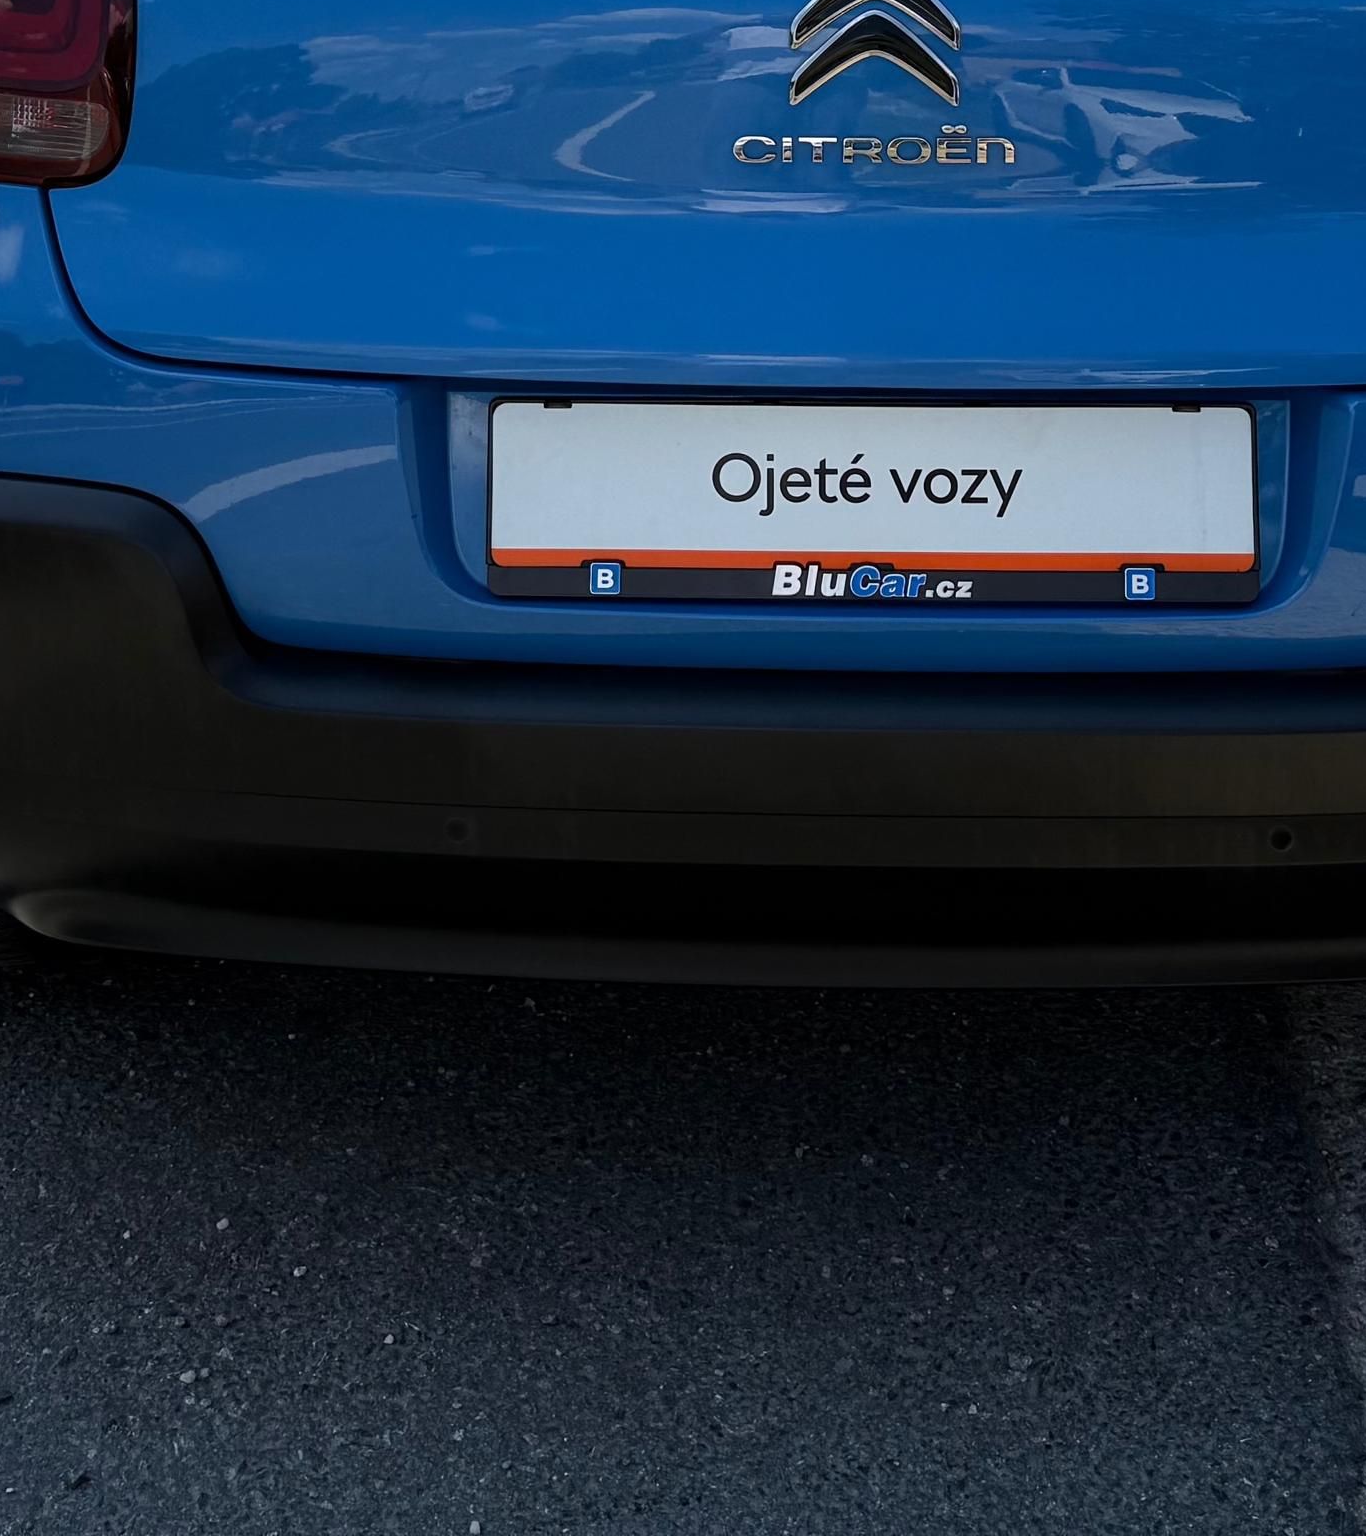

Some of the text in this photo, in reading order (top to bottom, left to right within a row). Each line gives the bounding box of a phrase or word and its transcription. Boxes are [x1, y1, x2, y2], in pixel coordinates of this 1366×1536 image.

[712, 453, 1023, 518] Ojeté vozy
[597, 569, 615, 590] B
[772, 564, 973, 598] BluCar.cz
[1132, 574, 1151, 594] B
